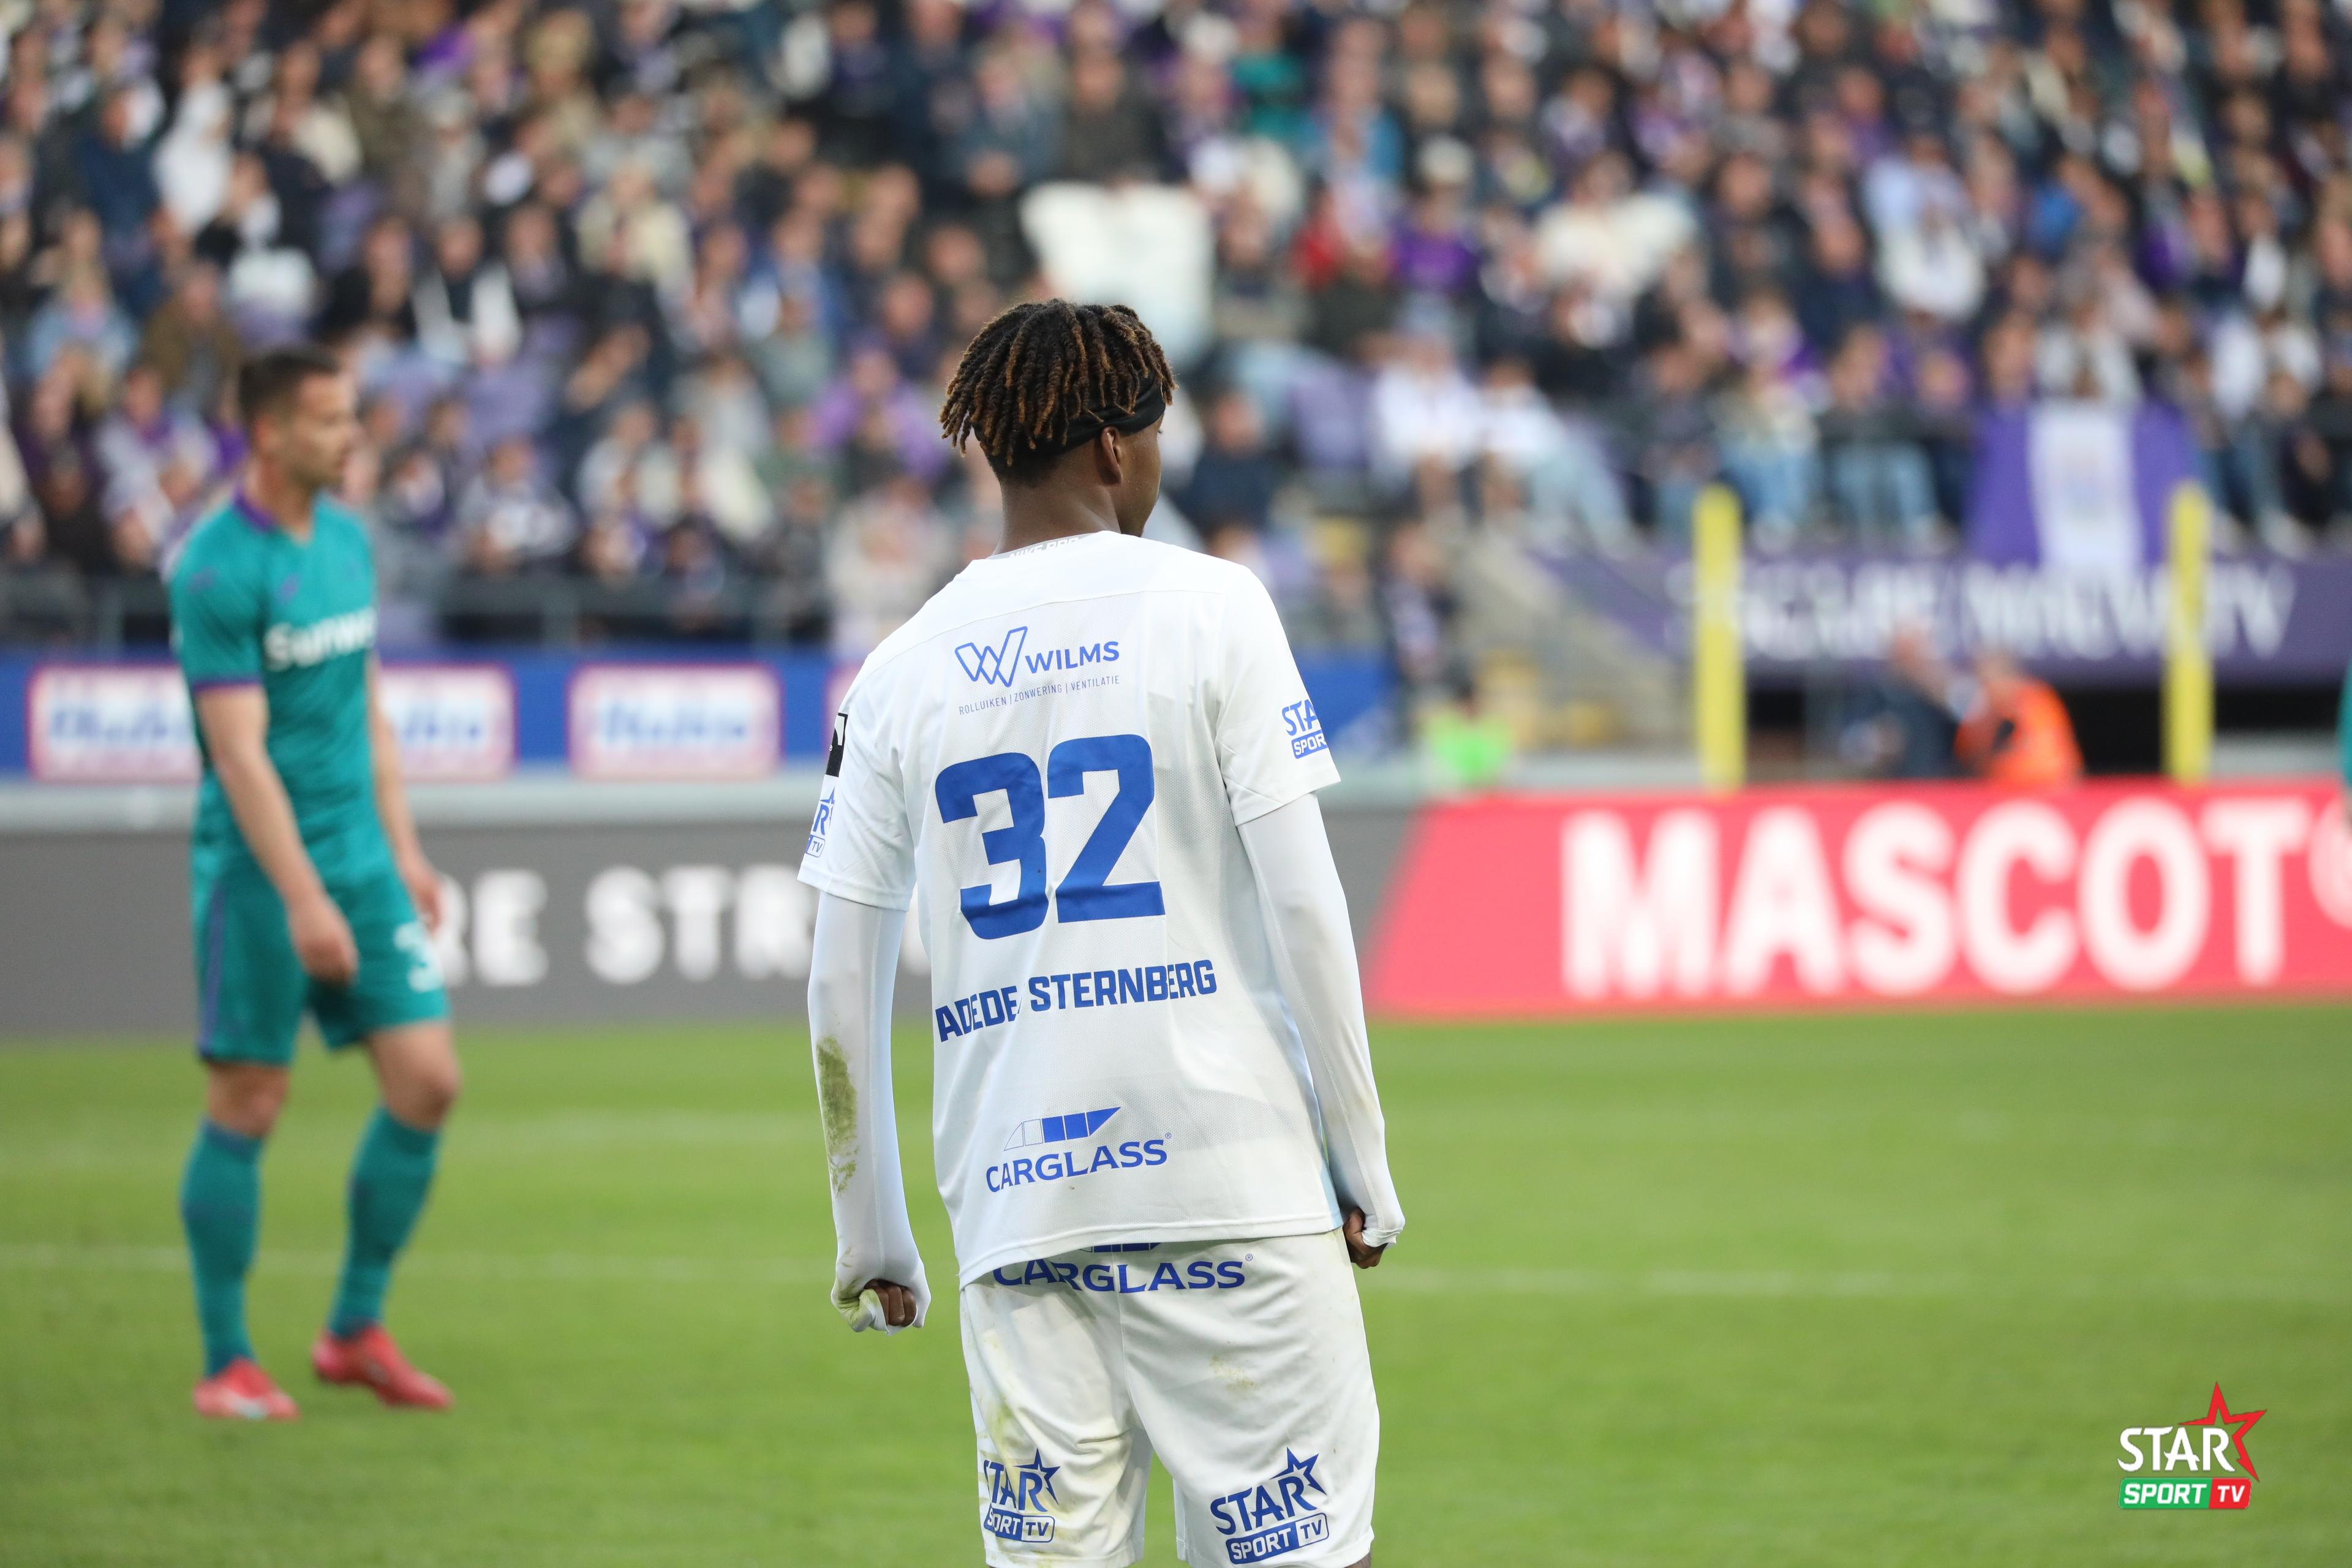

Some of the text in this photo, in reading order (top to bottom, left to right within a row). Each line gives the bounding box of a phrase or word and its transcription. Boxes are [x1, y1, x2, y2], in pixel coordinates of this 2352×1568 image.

[1025, 641, 1120, 674] WILMS
[959, 675, 1120, 715] ROLLUIKEN ZONWERING VENTILATIE
[935, 734, 1166, 940] 32
[1559, 796, 2312, 1000] MASCOT
[935, 959, 1218, 1042] ADEDE STERNBERG
[1026, 1522, 1049, 1537] TV
[1210, 1476, 1318, 1535] STAR
[1231, 1519, 1322, 1559] SPORT TV
